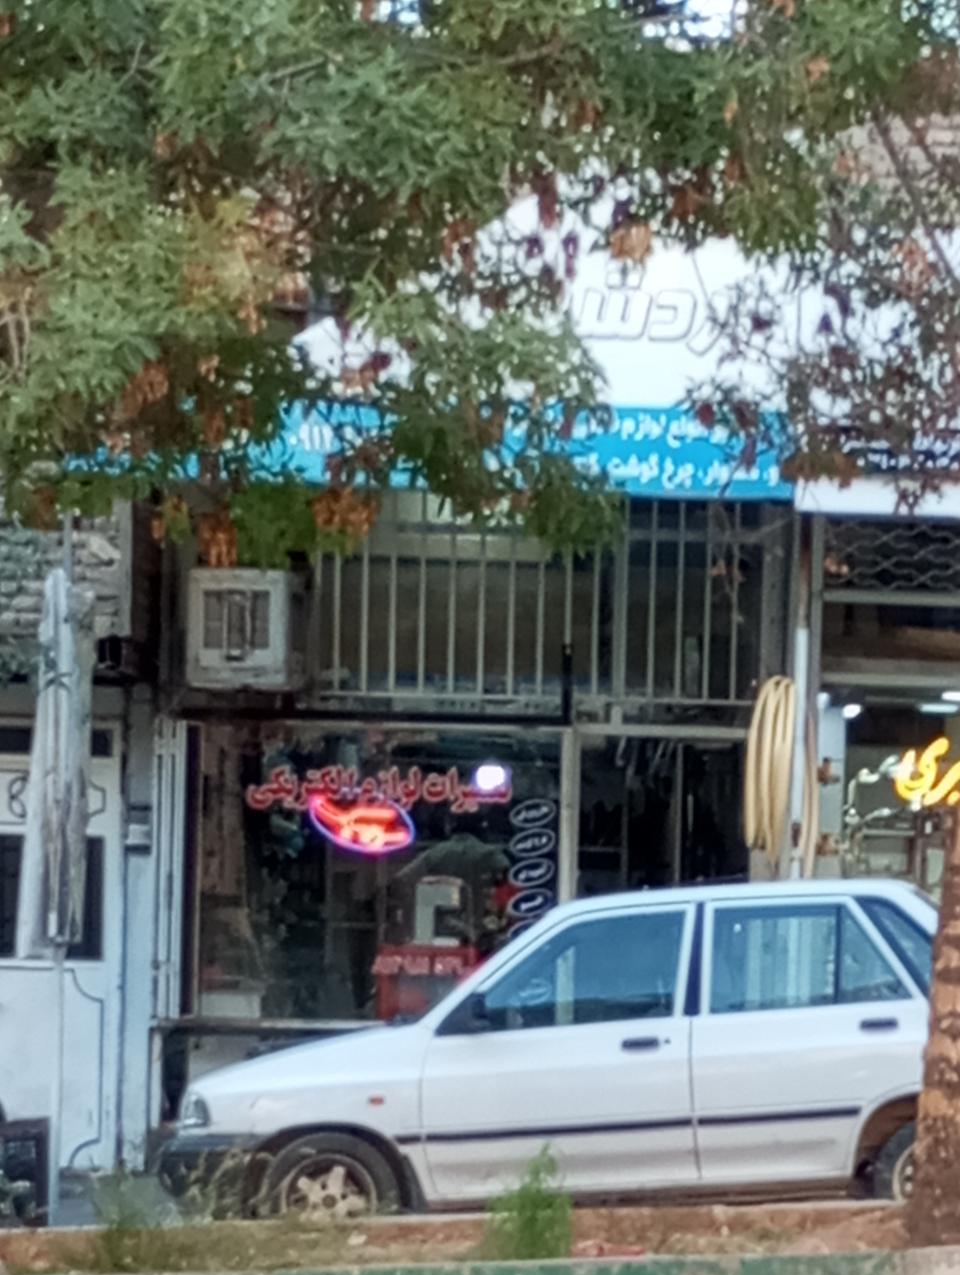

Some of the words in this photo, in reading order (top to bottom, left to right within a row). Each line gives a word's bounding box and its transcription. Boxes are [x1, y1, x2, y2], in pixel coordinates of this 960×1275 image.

[605, 451, 660, 484] گوشت
[246, 764, 357, 810] الکتریکی
[356, 765, 421, 813] لوازم
[423, 766, 512, 813] یرات
